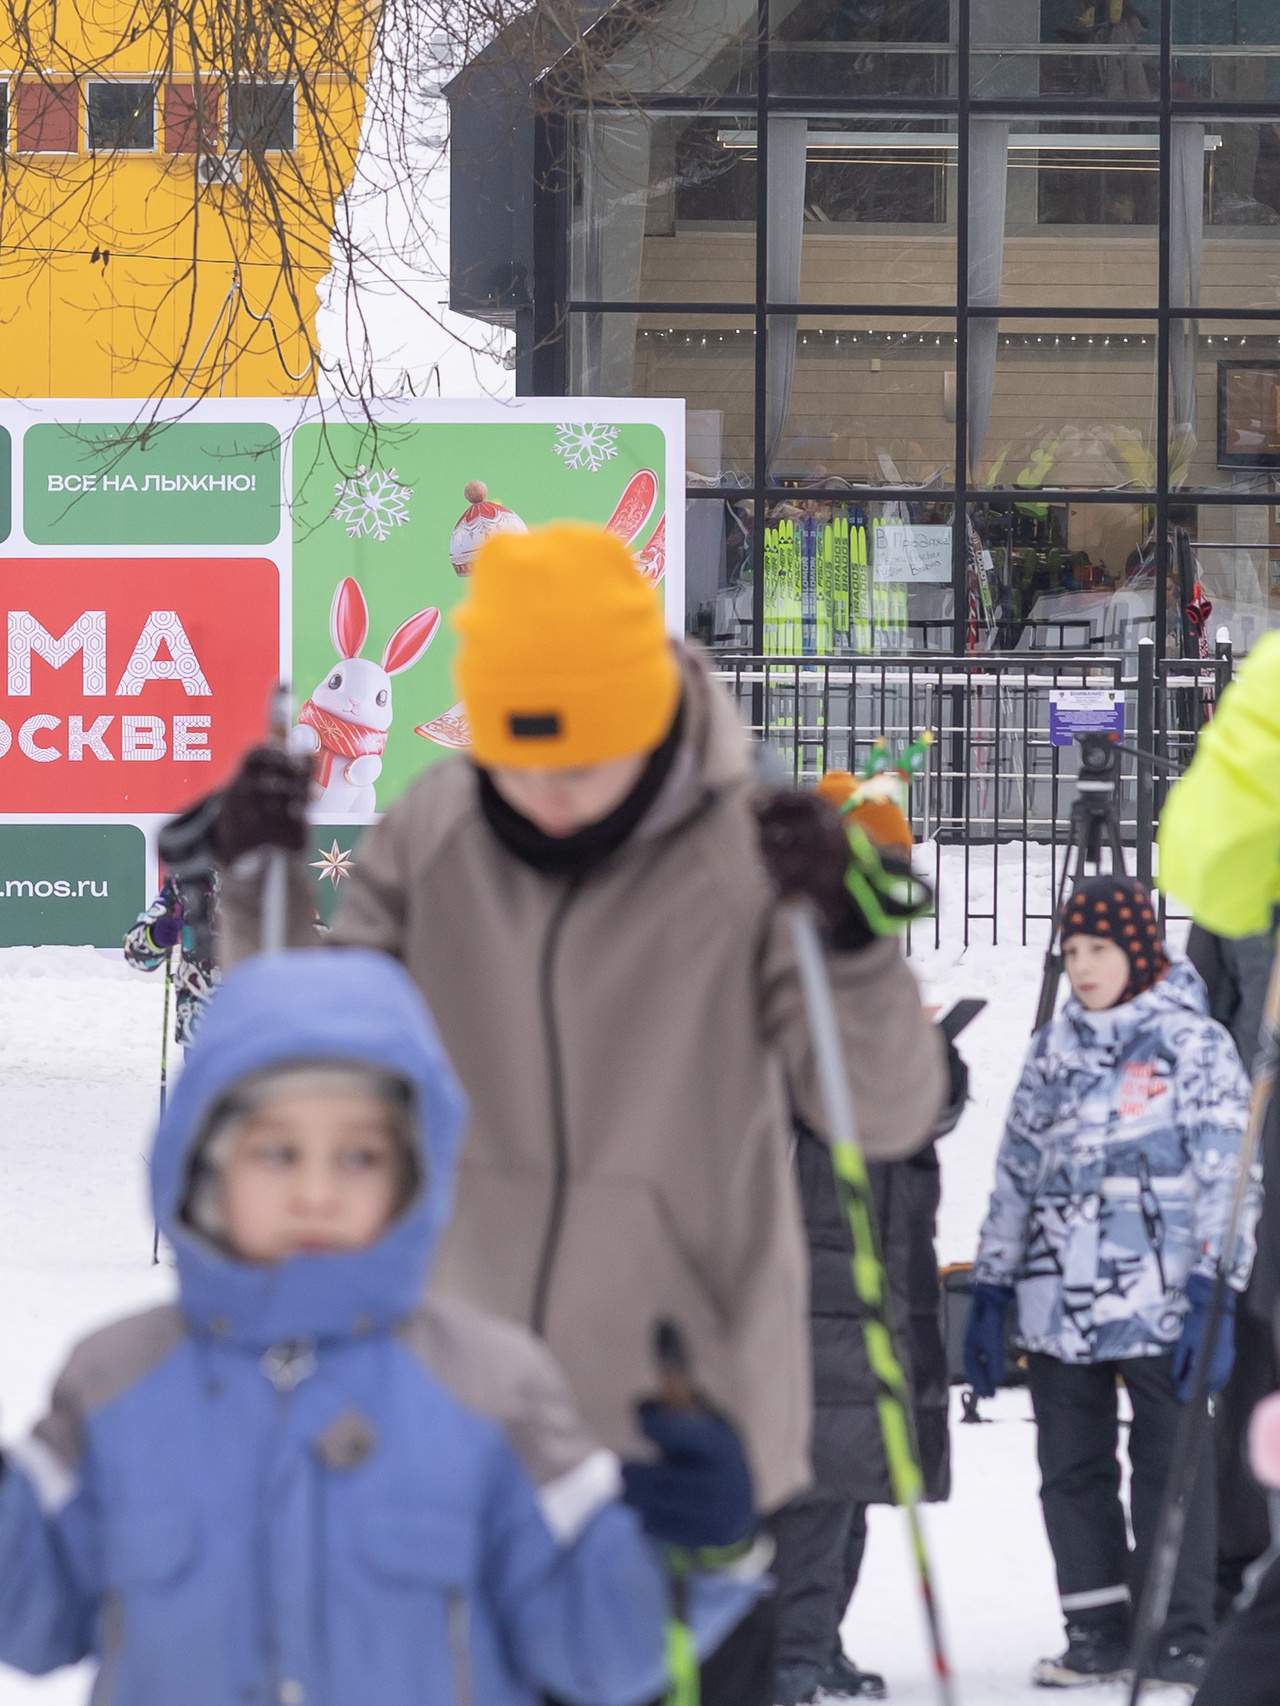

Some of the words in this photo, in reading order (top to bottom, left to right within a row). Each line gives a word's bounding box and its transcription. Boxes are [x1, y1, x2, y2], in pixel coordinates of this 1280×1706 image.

[47, 475, 97, 491] ВСЕ
[102, 475, 138, 491] НА
[141, 475, 256, 491] ЛЫЖНЮ!
[876, 528, 888, 549] В
